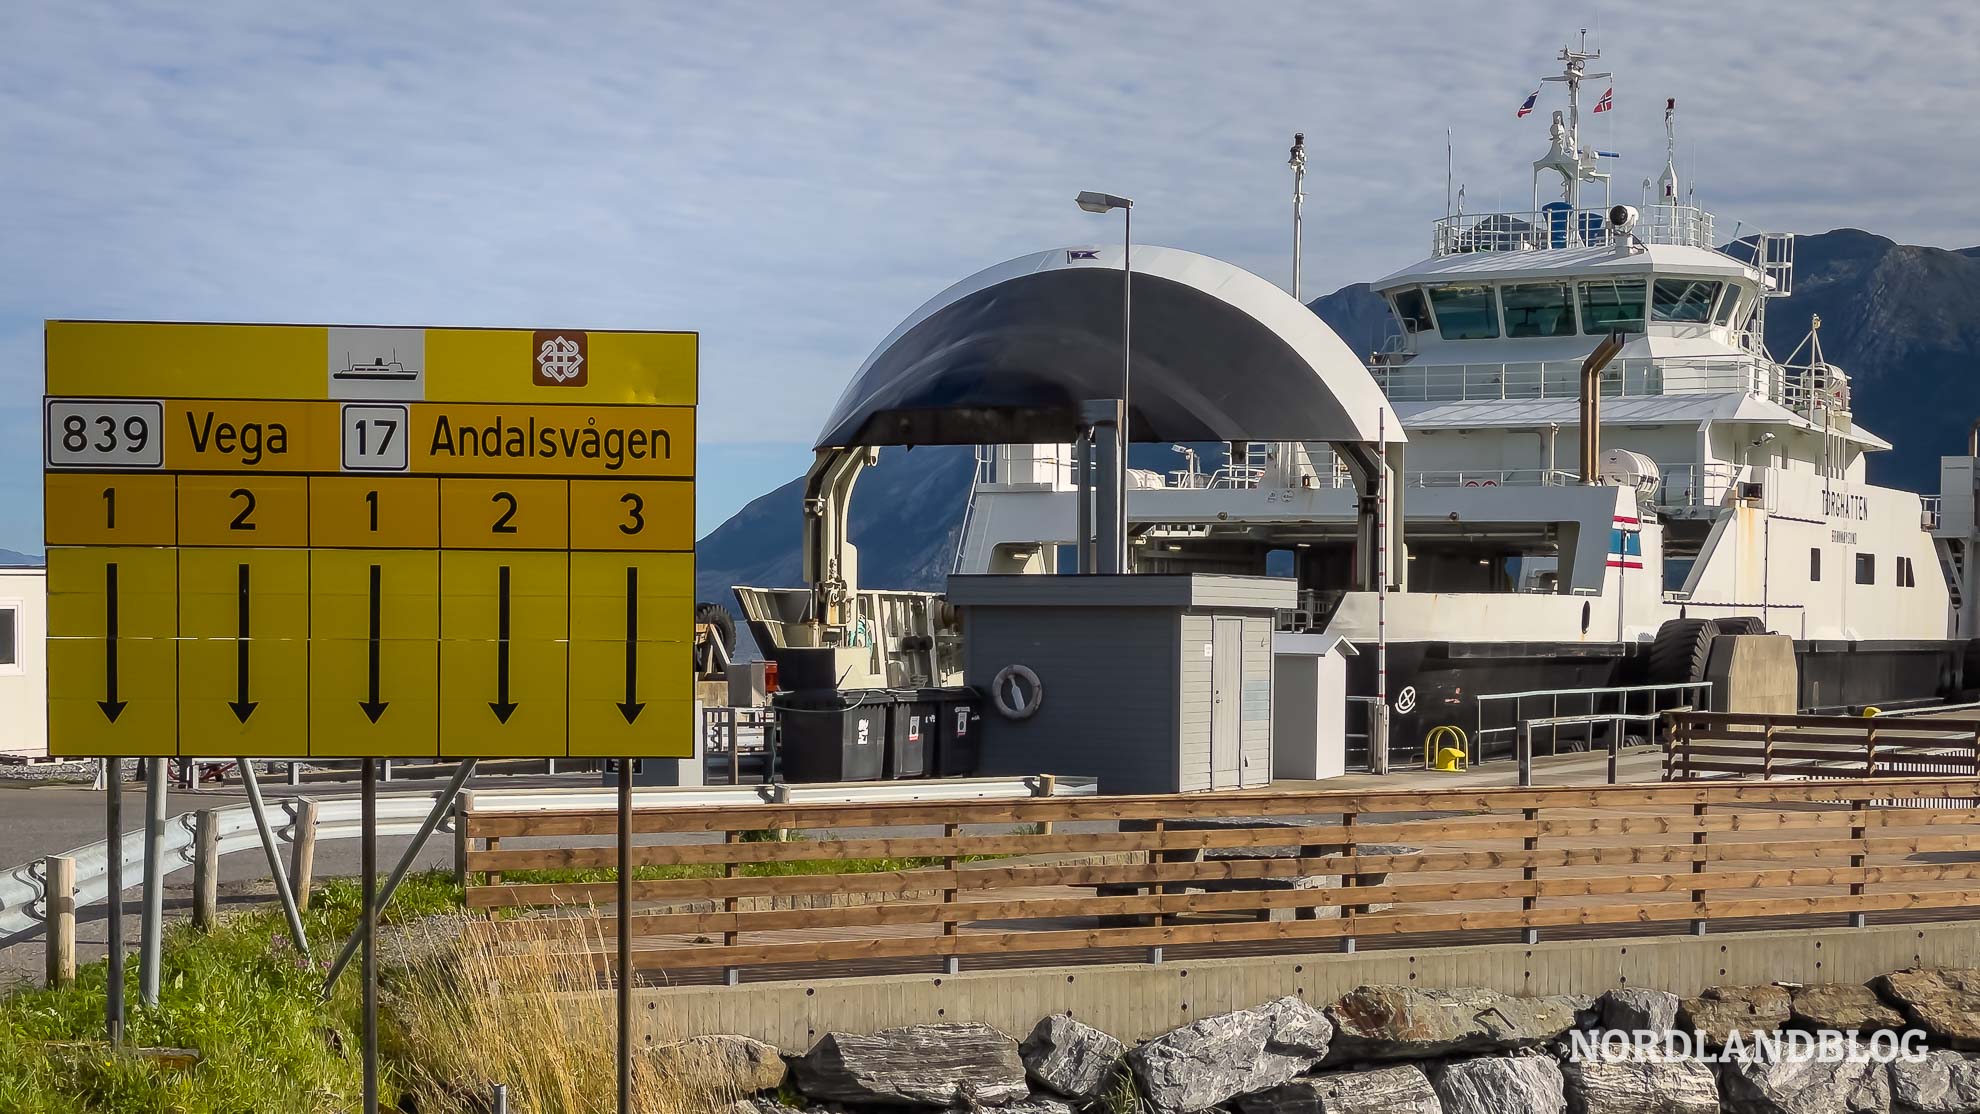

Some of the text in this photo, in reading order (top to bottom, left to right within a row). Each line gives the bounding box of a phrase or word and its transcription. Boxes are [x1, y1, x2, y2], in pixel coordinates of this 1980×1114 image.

[62, 411, 288, 466] 839 Vega
[355, 414, 671, 471] 17 Andalsvågen
[102, 487, 116, 530] 1
[228, 488, 257, 531] 2
[365, 490, 379, 532] 1
[491, 491, 518, 534] 2
[618, 492, 645, 535] 3
